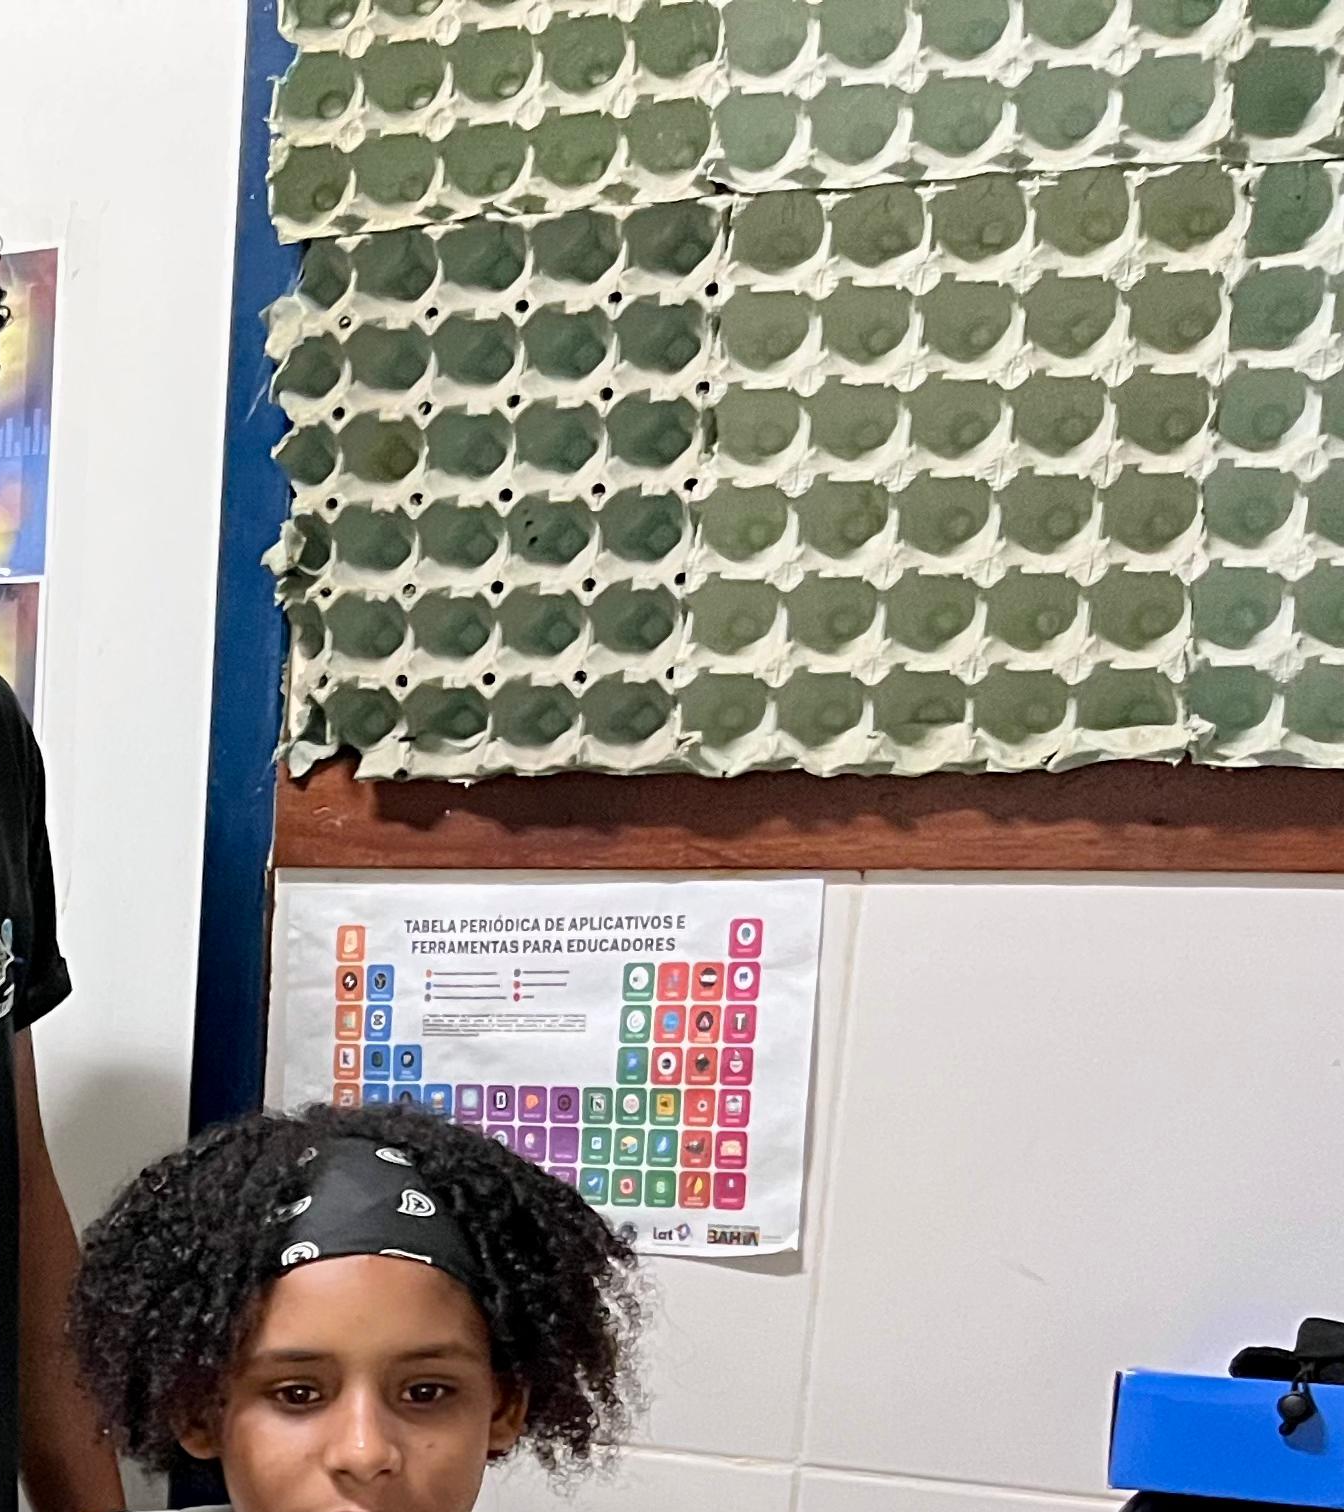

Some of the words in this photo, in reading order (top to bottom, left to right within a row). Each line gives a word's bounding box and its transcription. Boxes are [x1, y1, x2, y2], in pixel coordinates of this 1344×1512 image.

[404, 919, 457, 934] TABELA
[460, 914, 541, 933] PERIÓDICA
[544, 917, 564, 931] DE
[568, 915, 674, 932] APLICATIVOS
[676, 914, 687, 930] E
[411, 939, 519, 955] FERRAMENTAS
[522, 938, 564, 954] PARA
[567, 937, 676, 953] EDUCADORES
